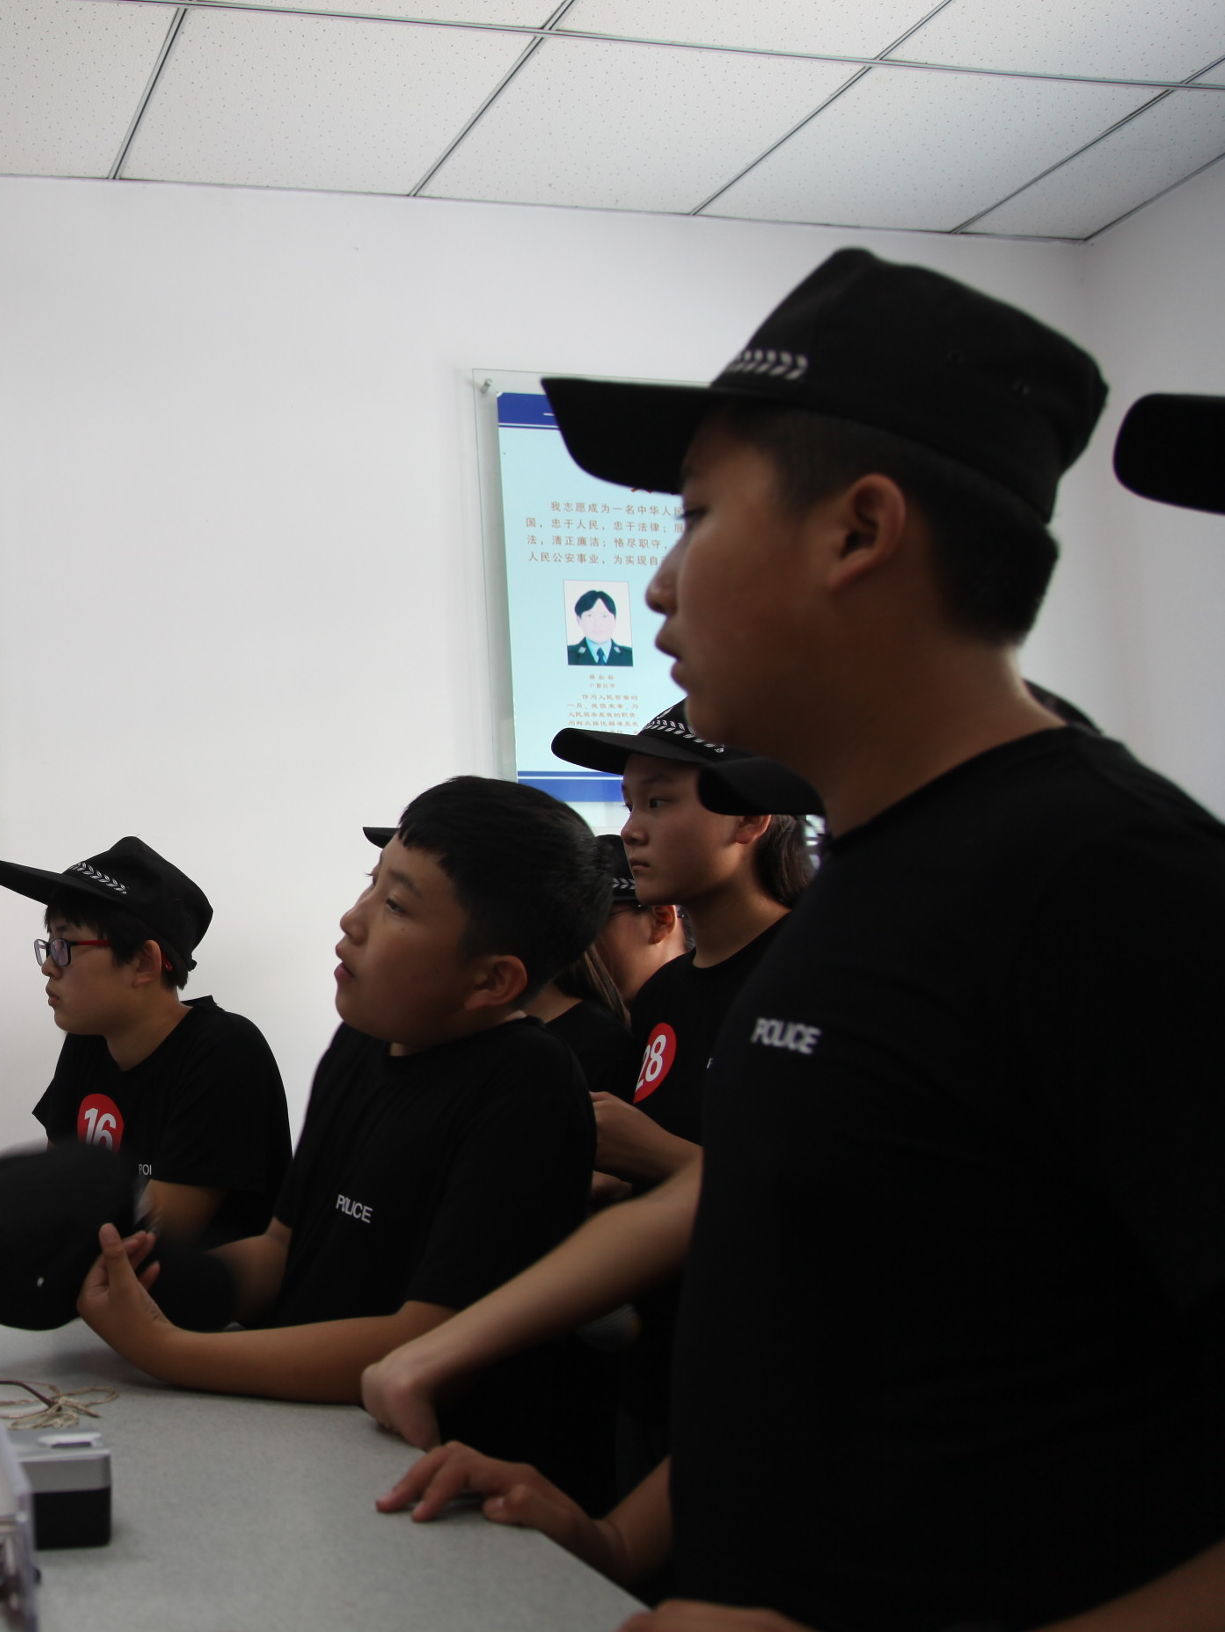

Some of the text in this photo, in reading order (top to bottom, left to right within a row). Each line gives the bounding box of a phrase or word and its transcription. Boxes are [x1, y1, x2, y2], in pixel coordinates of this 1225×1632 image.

[751, 1018, 820, 1054] POLICE
[84, 1107, 116, 1148] 16
[336, 1193, 373, 1224] POLICE
